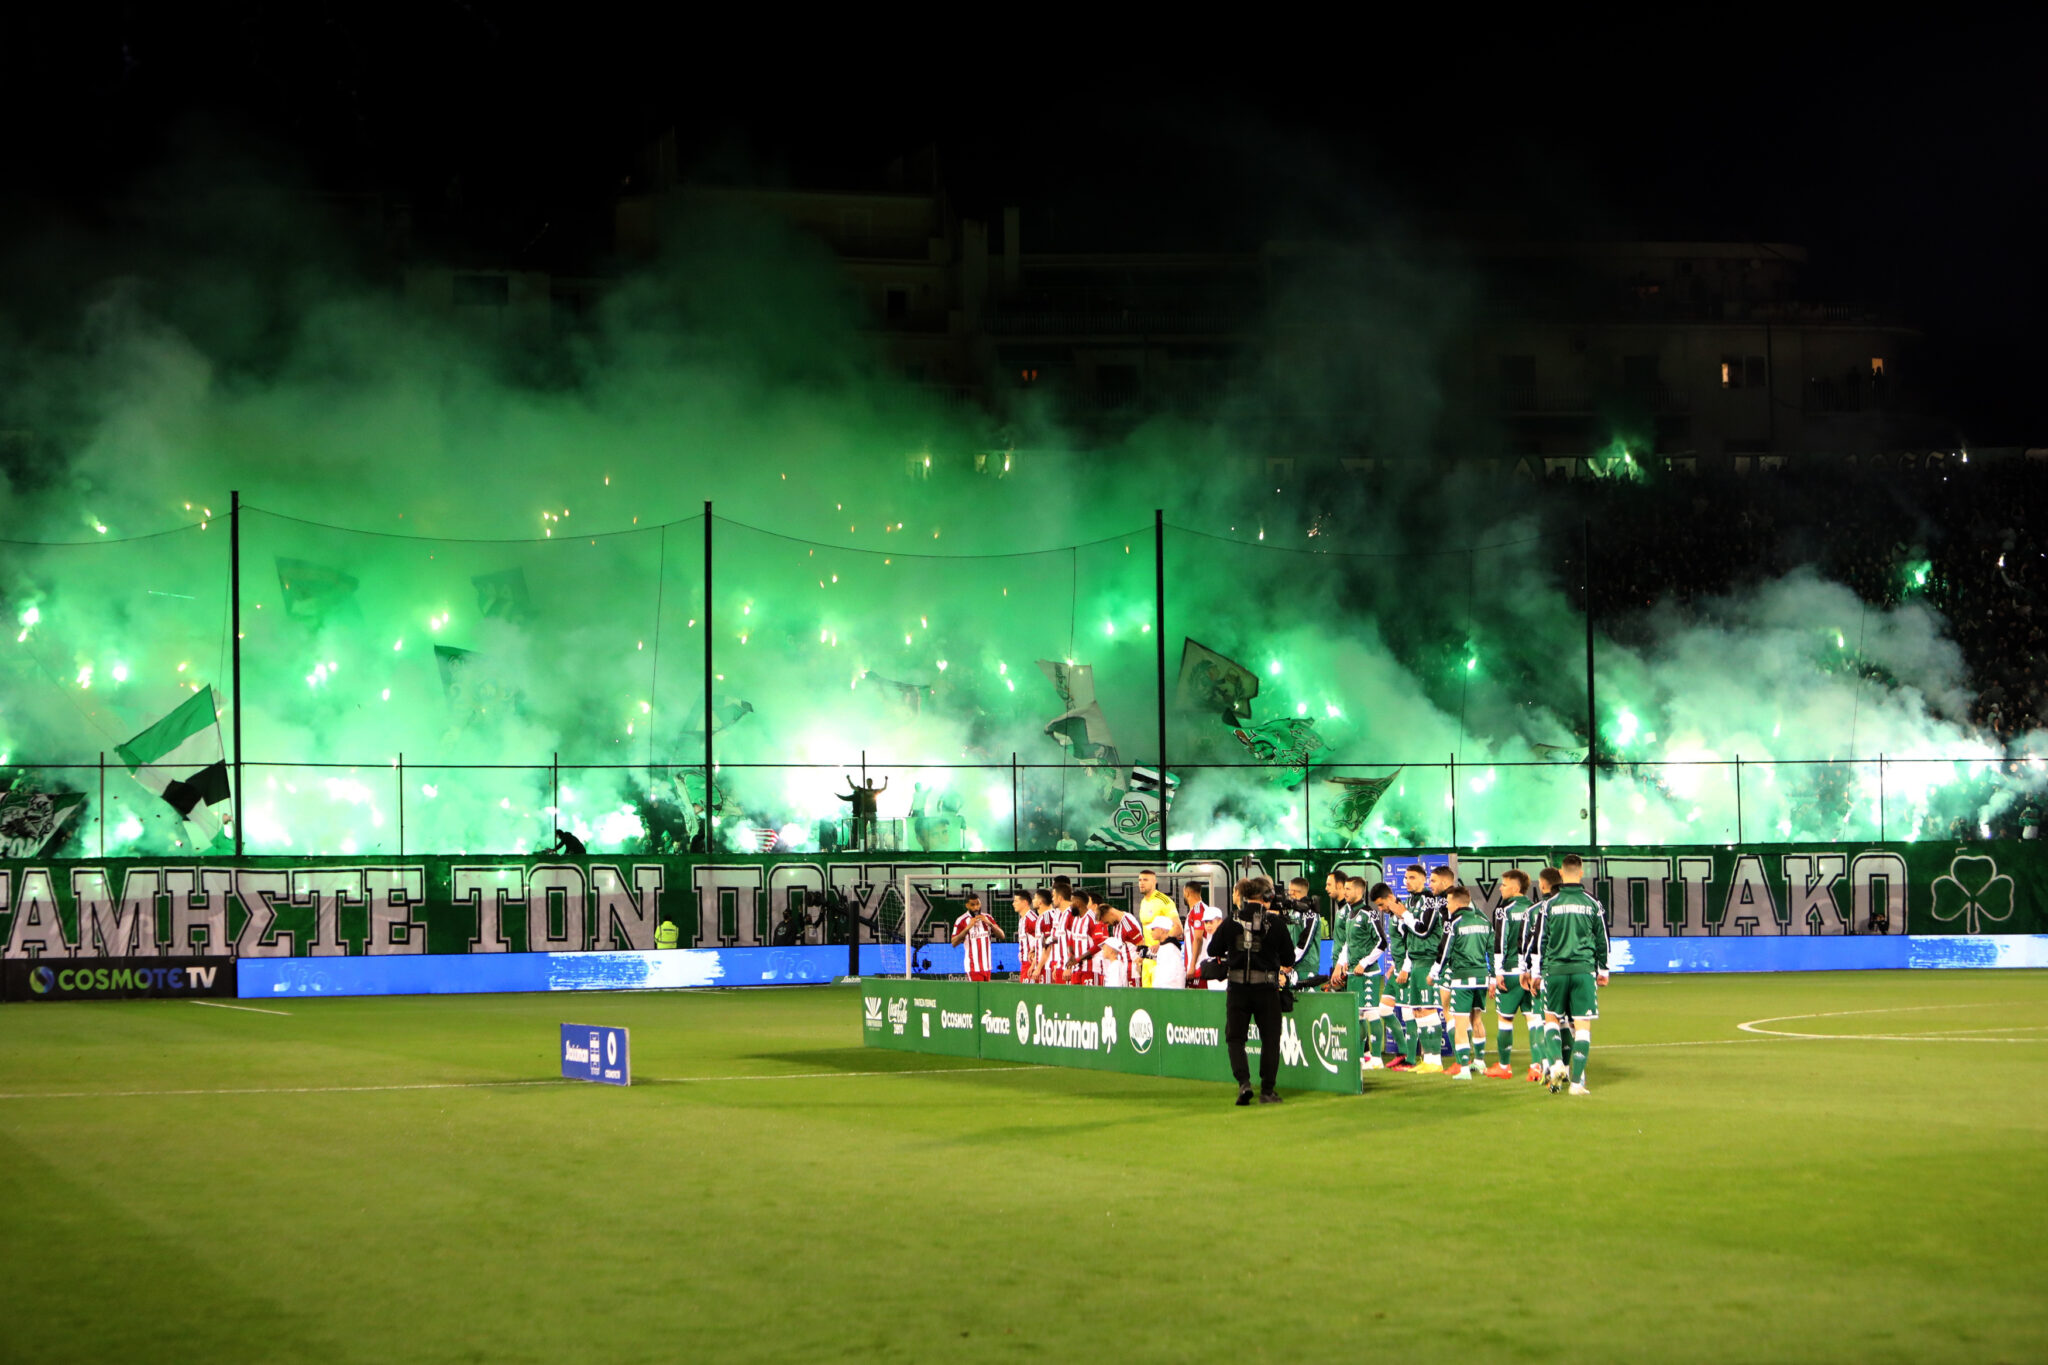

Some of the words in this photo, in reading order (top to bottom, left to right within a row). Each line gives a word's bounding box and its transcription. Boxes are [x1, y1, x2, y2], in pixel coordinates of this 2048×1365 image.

[0, 865, 428, 958] ΑΜΗΣΤΕ
[451, 863, 663, 955] ΤΟΝ
[58, 968, 184, 990] COSMOTE
[185, 966, 217, 989] TV
[1032, 1004, 1099, 1050] Stoiximan
